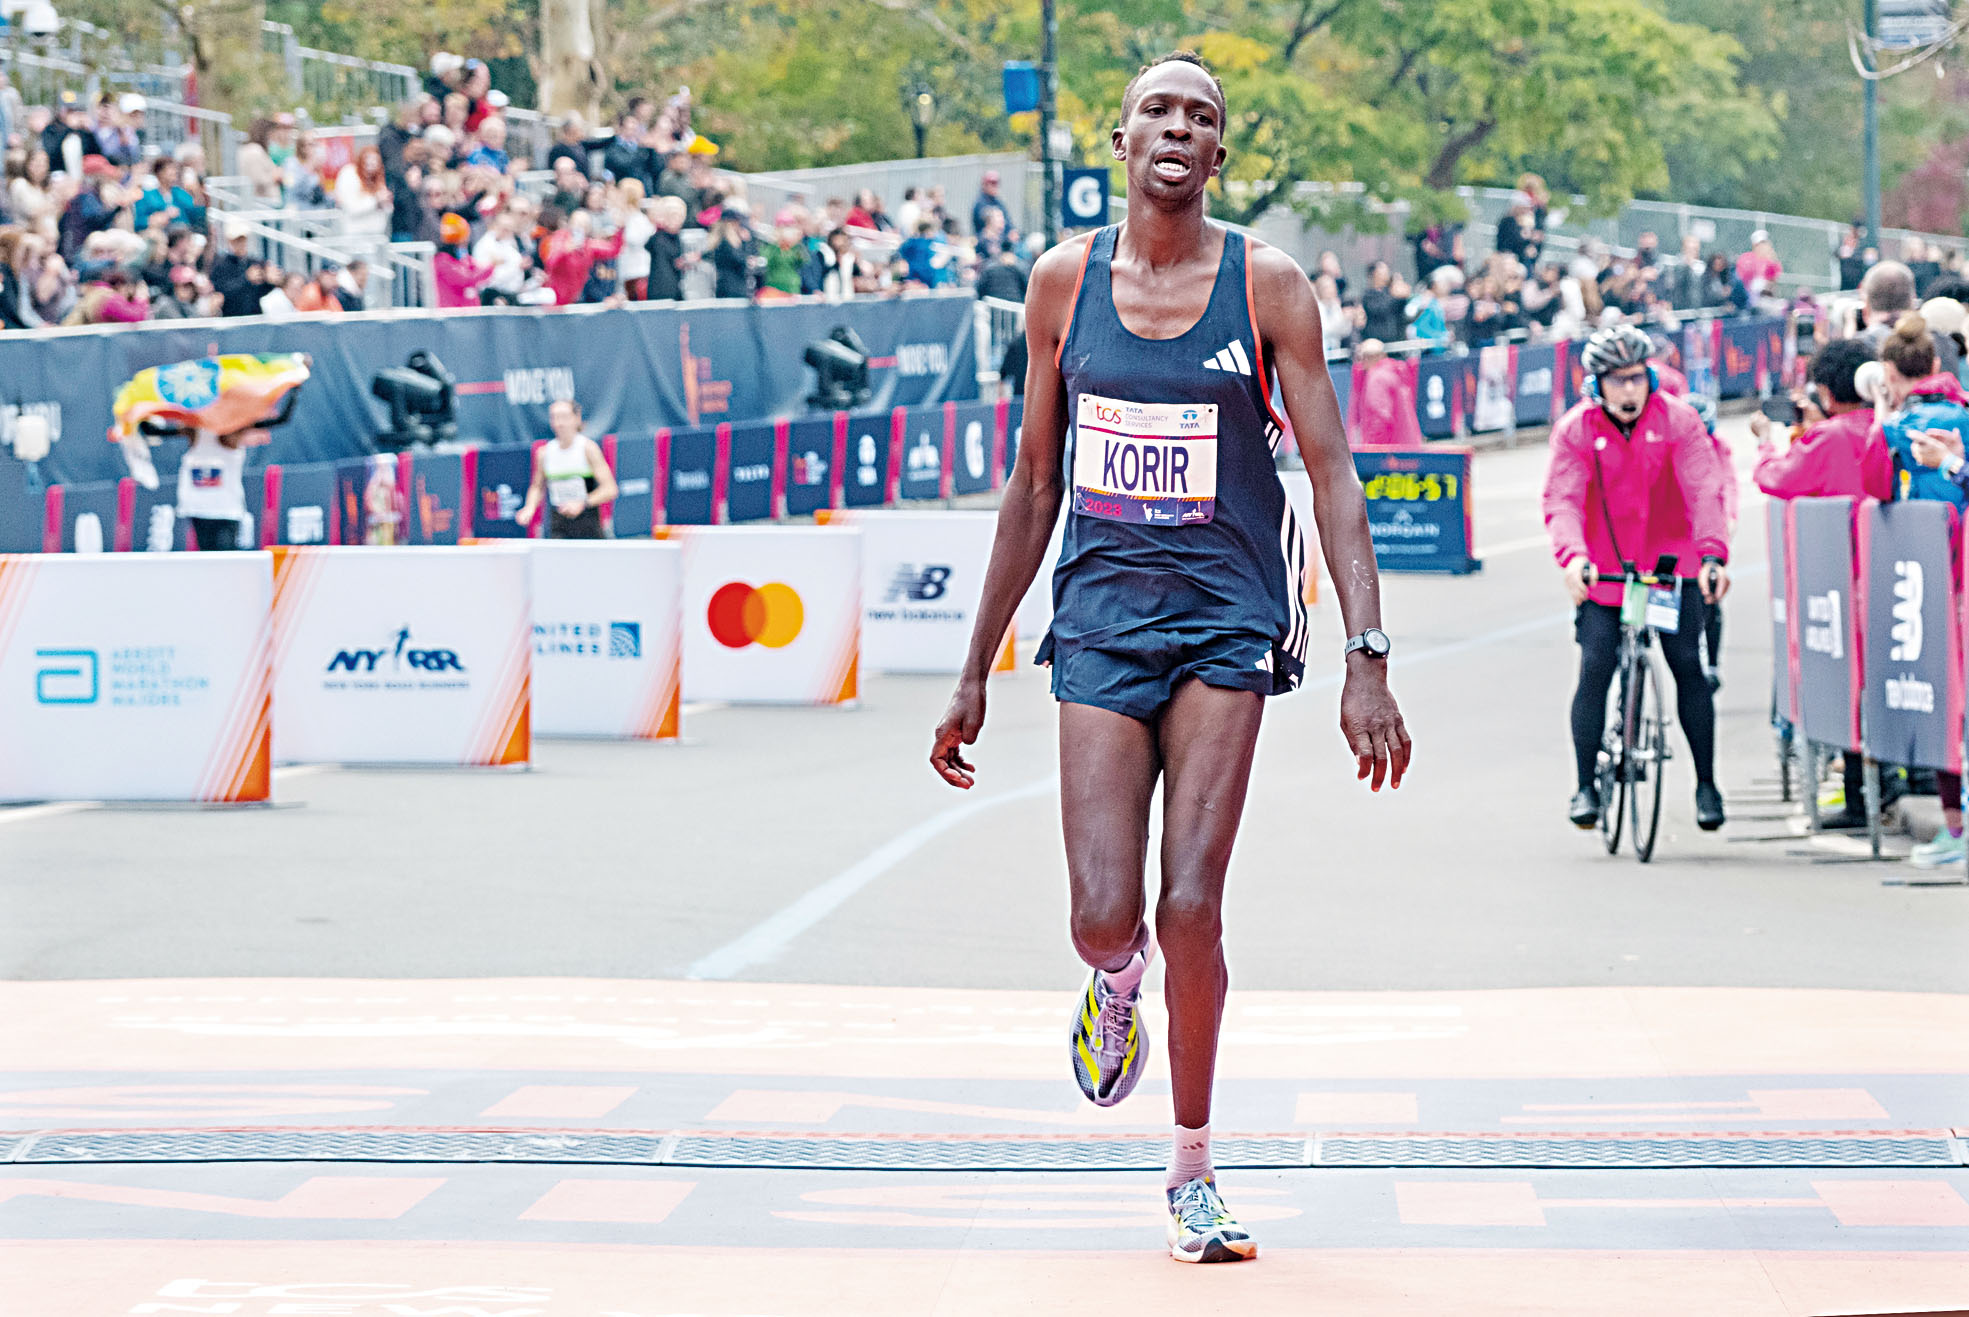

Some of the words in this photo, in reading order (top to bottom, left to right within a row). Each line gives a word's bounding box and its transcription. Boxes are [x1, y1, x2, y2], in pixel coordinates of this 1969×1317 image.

[1068, 175, 1102, 218] G
[1096, 403, 1122, 424] tcs
[1124, 414, 1169, 422] CONSULTANCY
[1103, 440, 1189, 493] KORIR
[1085, 498, 1122, 517] 2023
[533, 624, 601, 637] NITED
